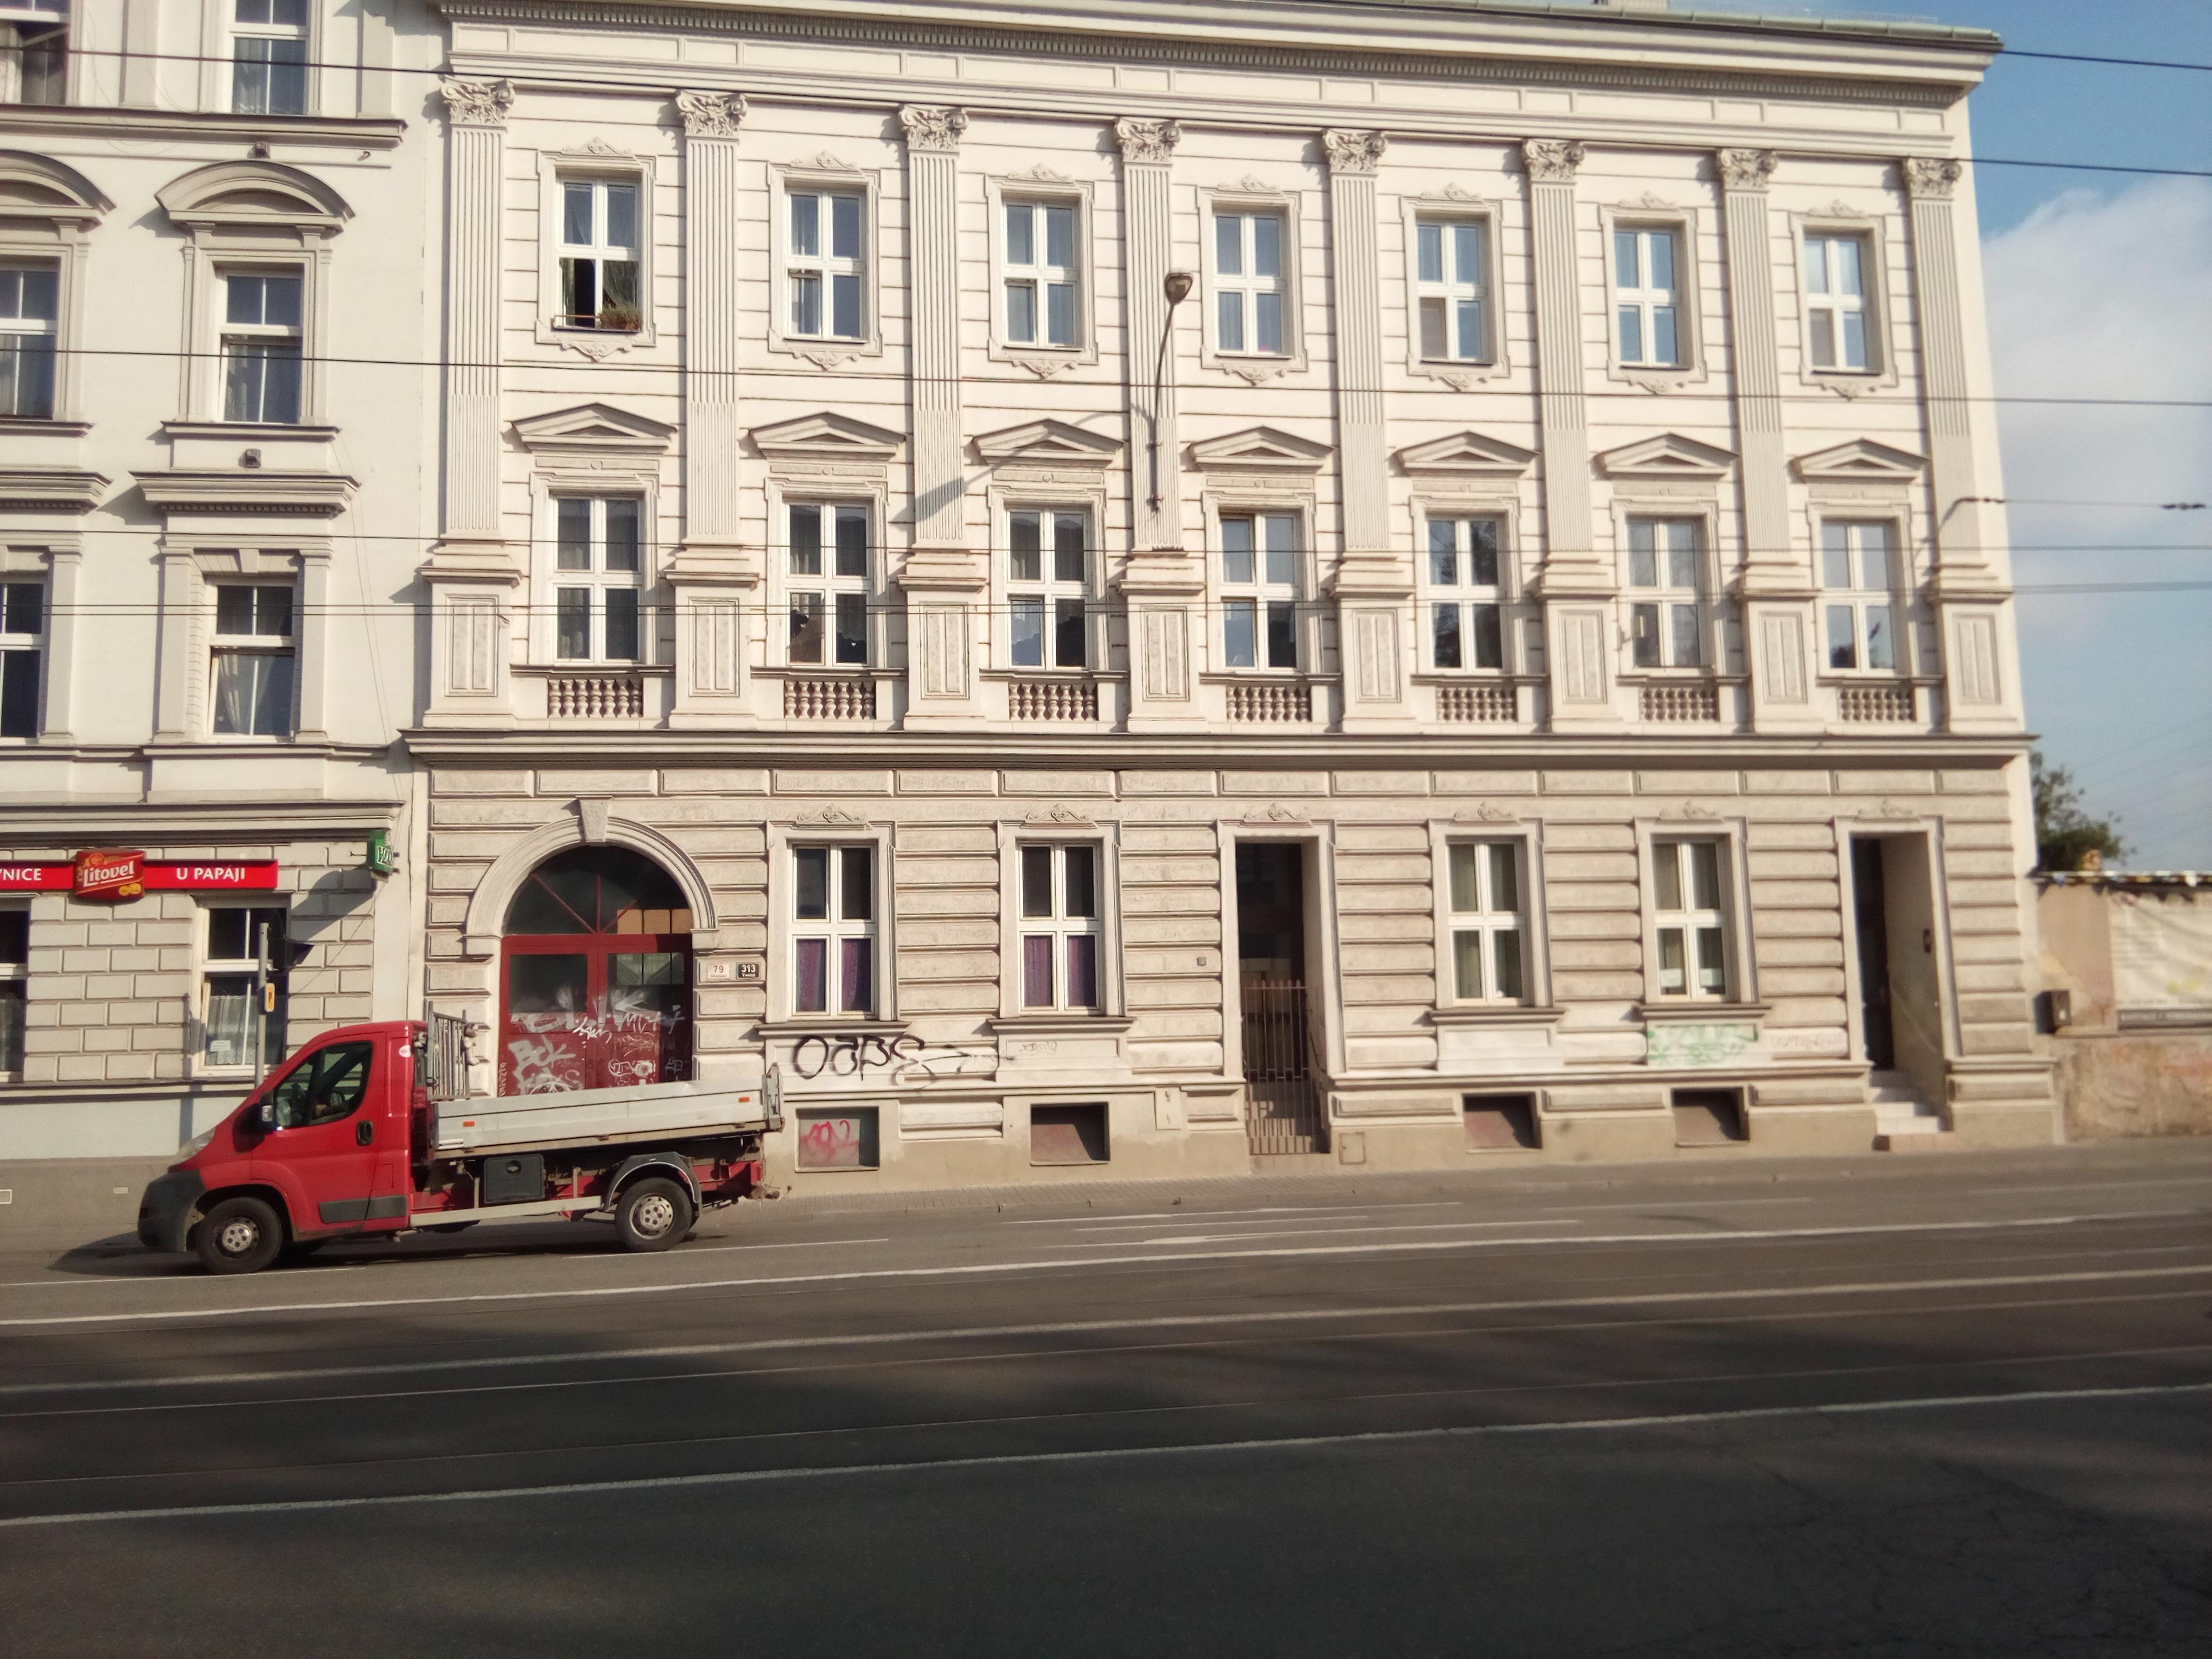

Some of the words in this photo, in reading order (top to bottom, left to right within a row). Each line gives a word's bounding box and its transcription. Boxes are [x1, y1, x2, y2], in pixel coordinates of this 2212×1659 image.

[0, 868, 42, 881] NICE
[83, 860, 134, 888] Litovel
[176, 867, 188, 880] U
[713, 965, 724, 973] 79
[741, 964, 756, 973] 313
